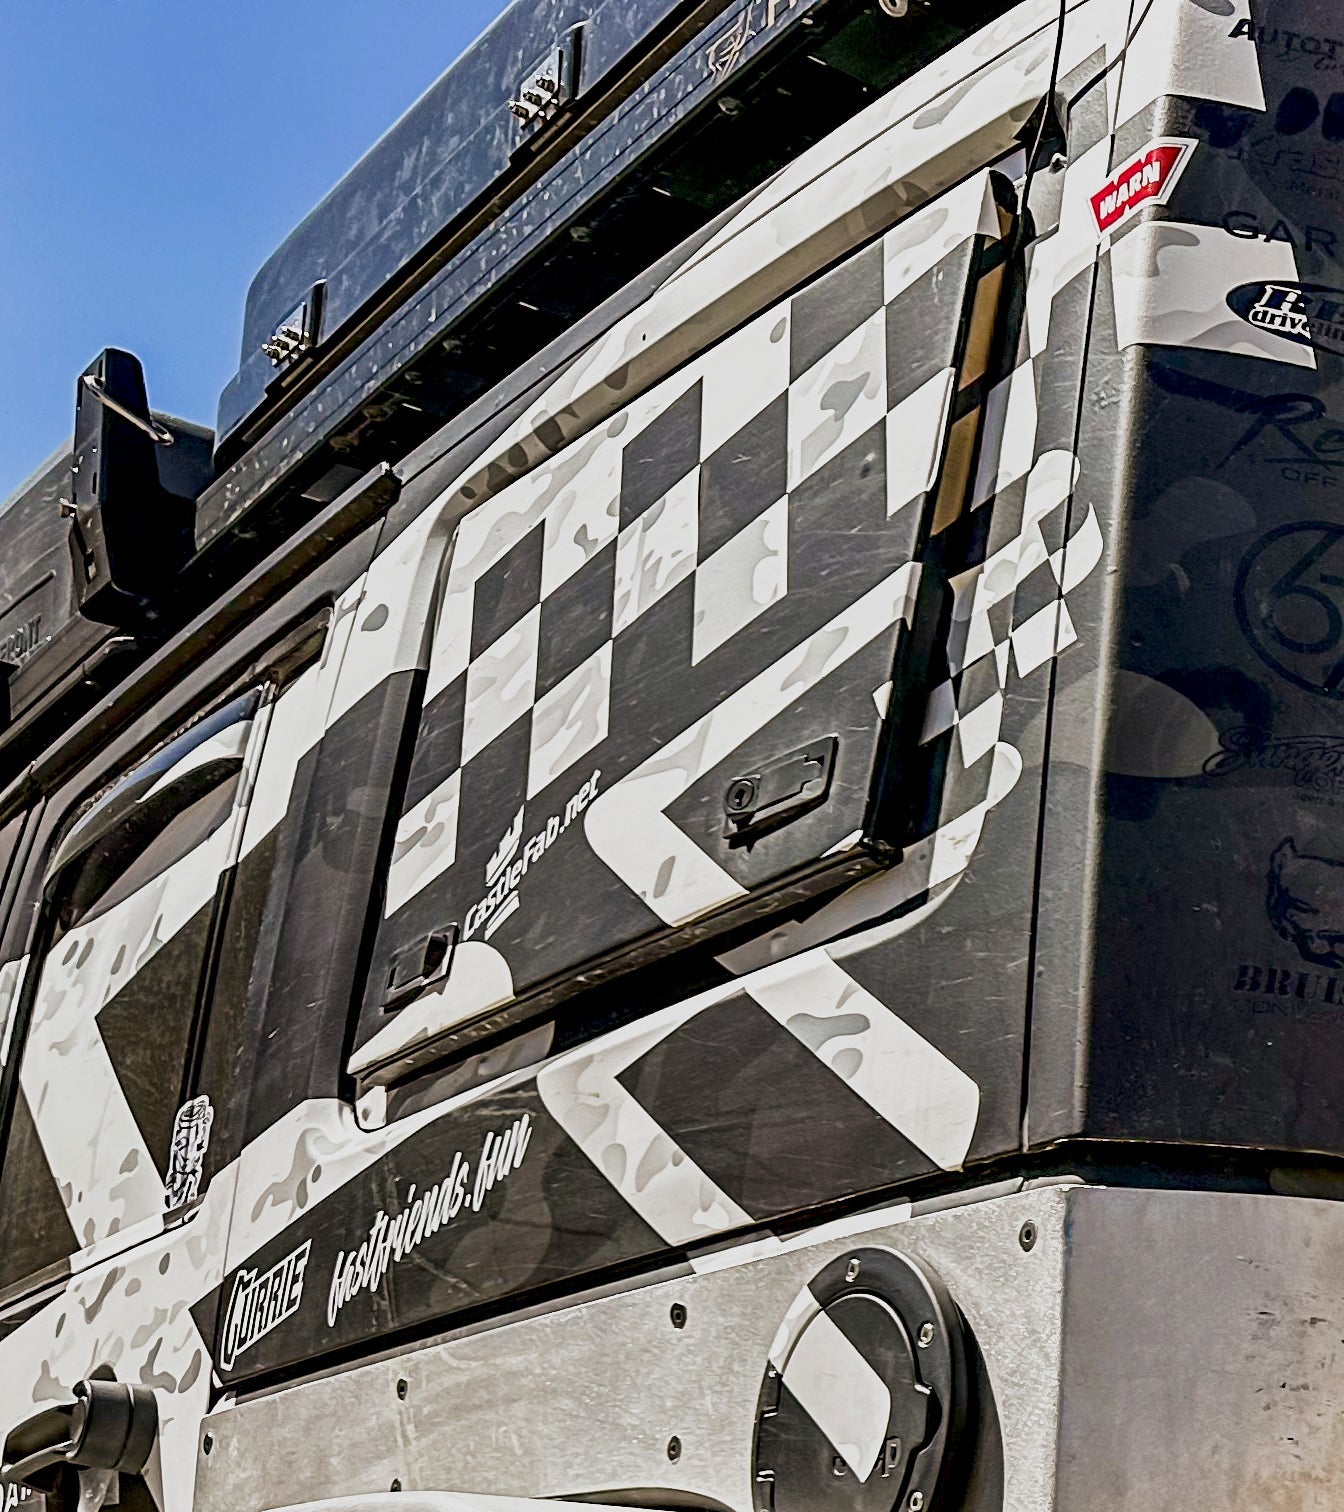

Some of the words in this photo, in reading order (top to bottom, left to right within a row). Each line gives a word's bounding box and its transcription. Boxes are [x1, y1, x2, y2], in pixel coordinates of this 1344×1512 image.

[1099, 160, 1161, 220] WARN
[1280, 466, 1338, 491] OFF
[463, 768, 602, 942] CastleFab.net
